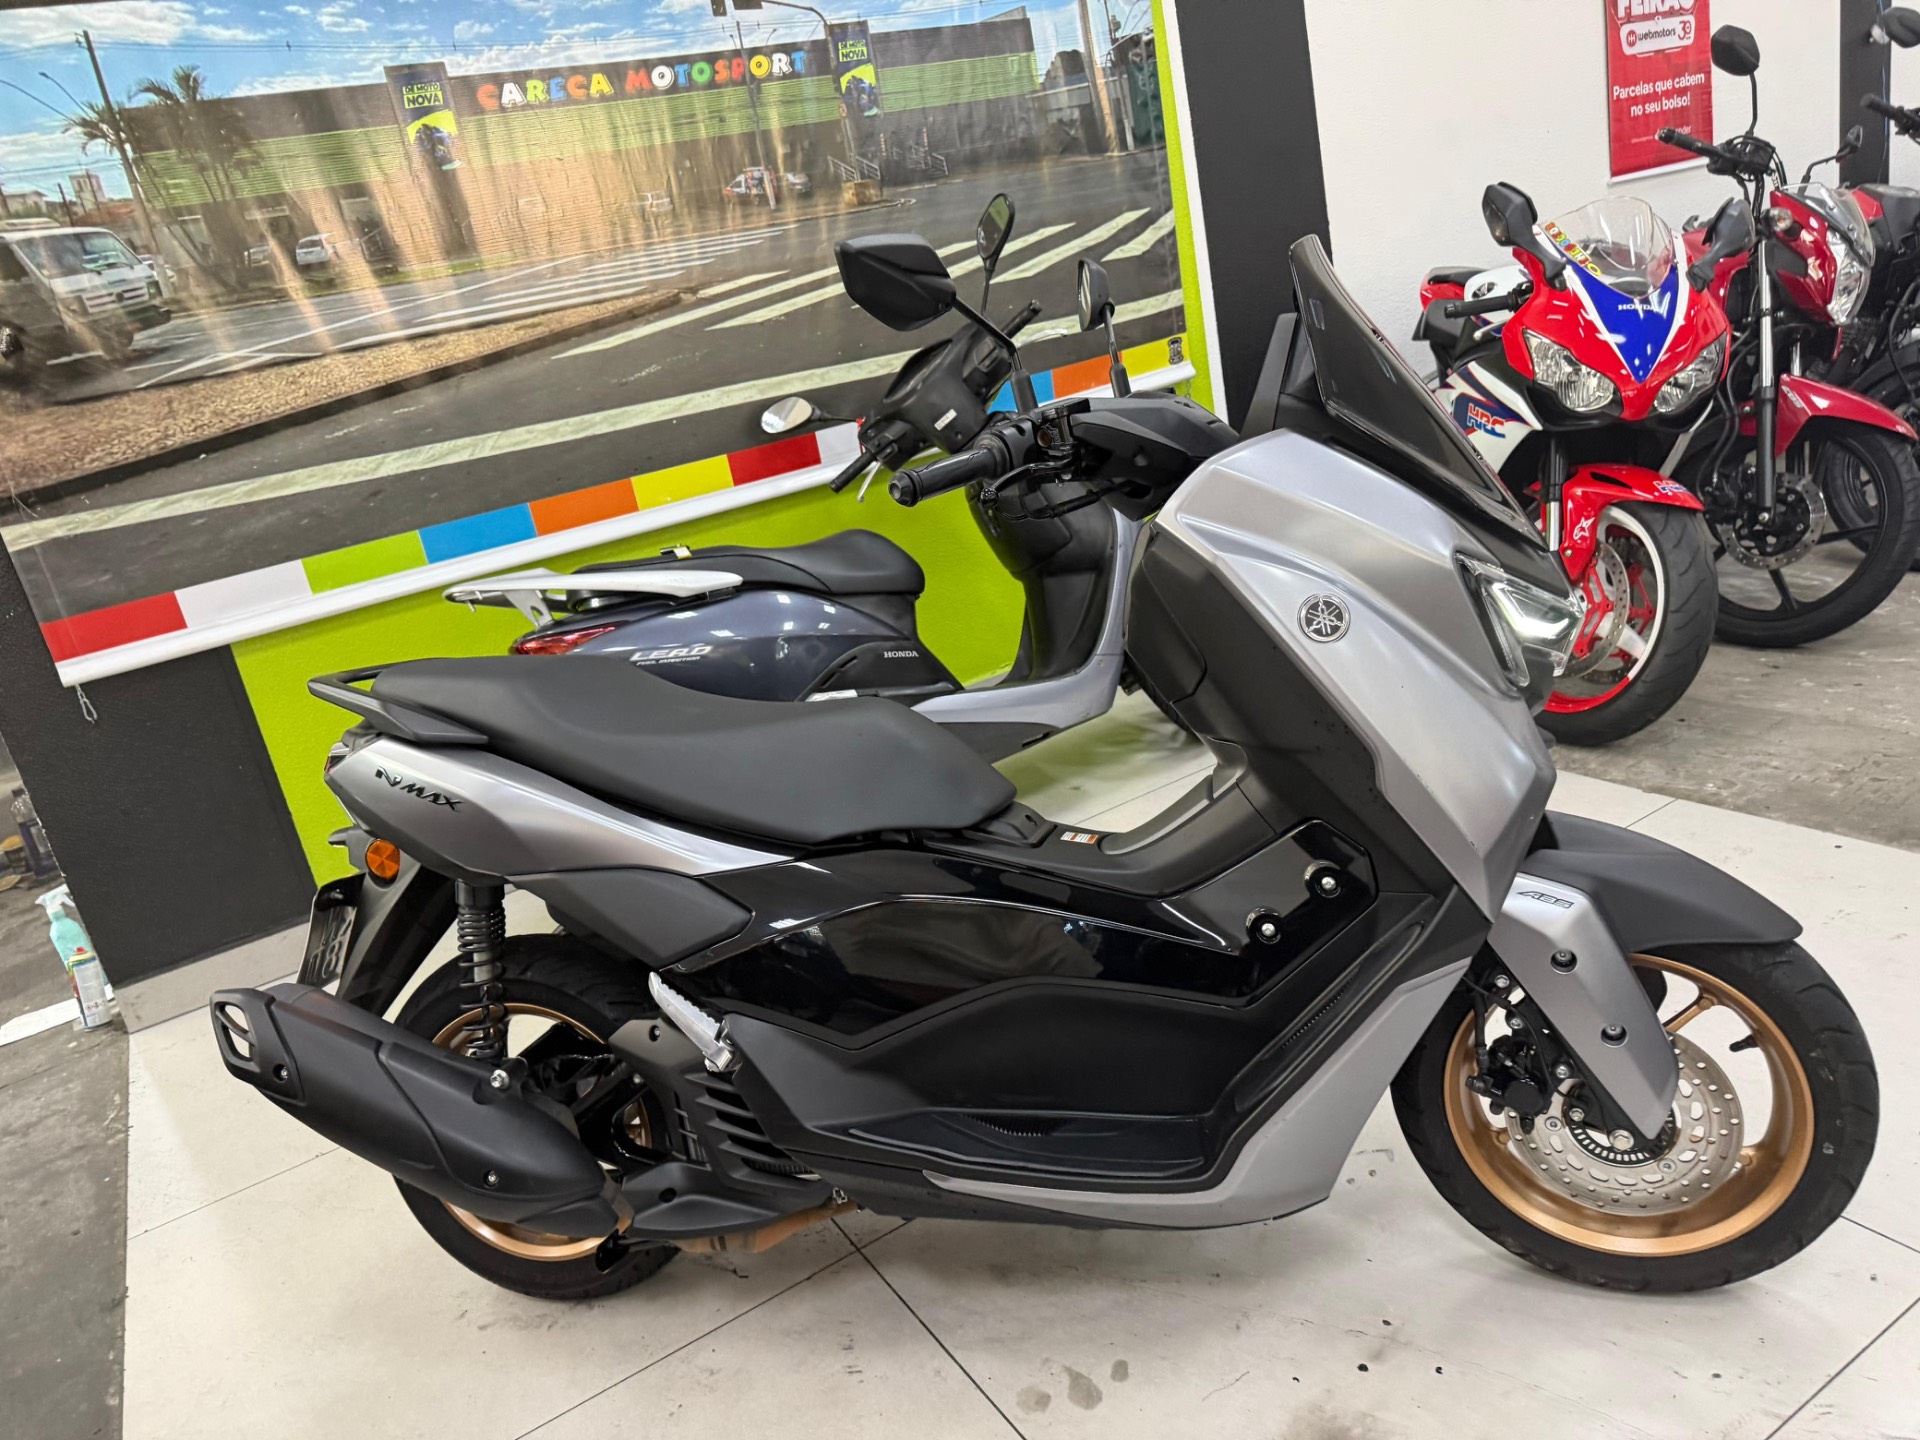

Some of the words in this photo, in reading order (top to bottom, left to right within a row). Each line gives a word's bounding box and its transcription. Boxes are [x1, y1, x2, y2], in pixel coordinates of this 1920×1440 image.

[1637, 28, 1676, 40] webmotors
[840, 48, 867, 61] NOVA
[477, 73, 614, 111] CARECA
[625, 50, 806, 93] MOTOSPORT
[1613, 81, 1653, 100] Parcelas
[1655, 79, 1673, 95] que
[1674, 73, 1705, 88] cabem
[405, 92, 442, 108] NOVA
[1630, 104, 1643, 117] no
[1645, 101, 1660, 114] seu
[1662, 91, 1690, 110] bolso!
[629, 645, 714, 662] LEAD
[883, 650, 919, 659] HONDA
[375, 766, 463, 813] NMAX
[1516, 890, 1575, 909] ABS
